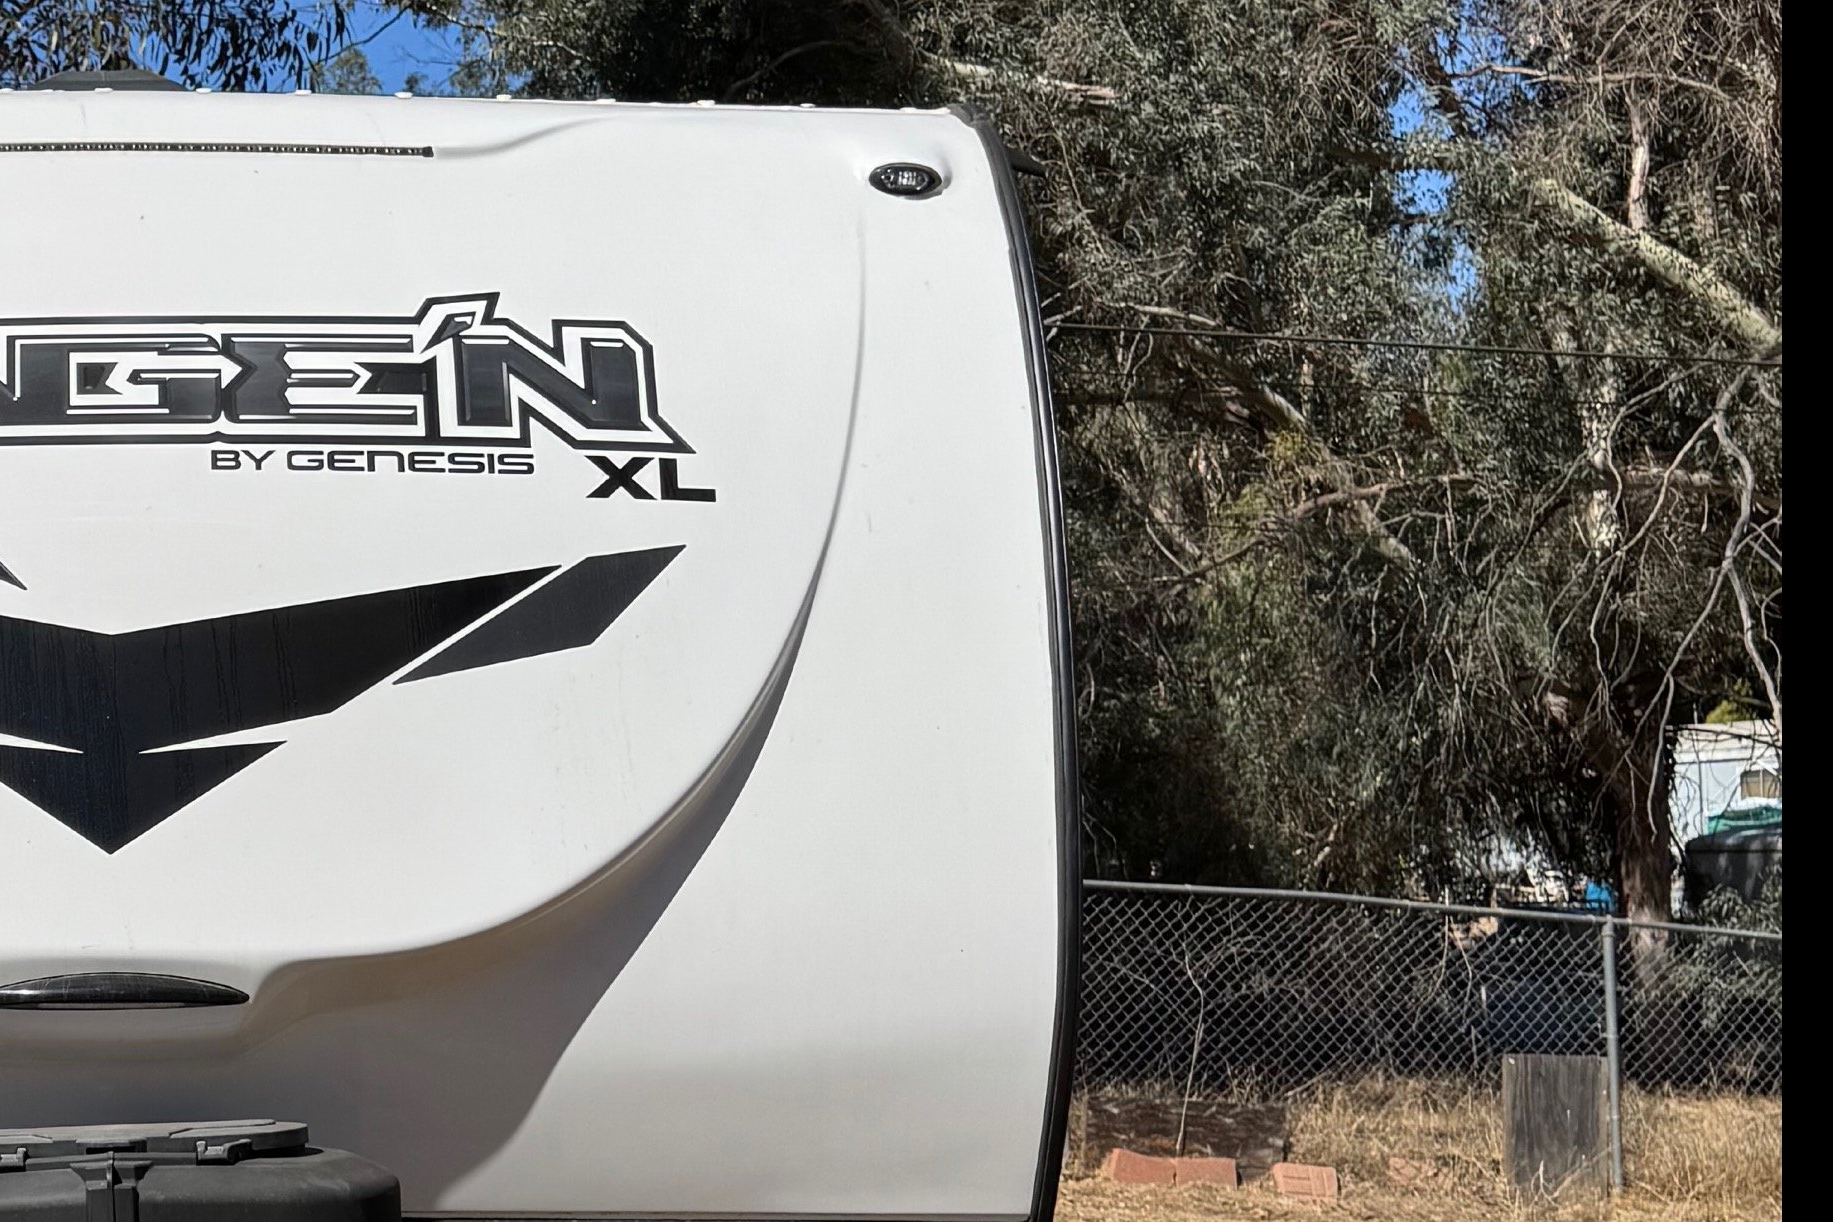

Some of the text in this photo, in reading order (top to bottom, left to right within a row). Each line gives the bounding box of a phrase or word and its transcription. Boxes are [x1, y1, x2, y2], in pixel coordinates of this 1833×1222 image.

[210, 449, 535, 475] BY GENESIS
[584, 455, 717, 503] XL
